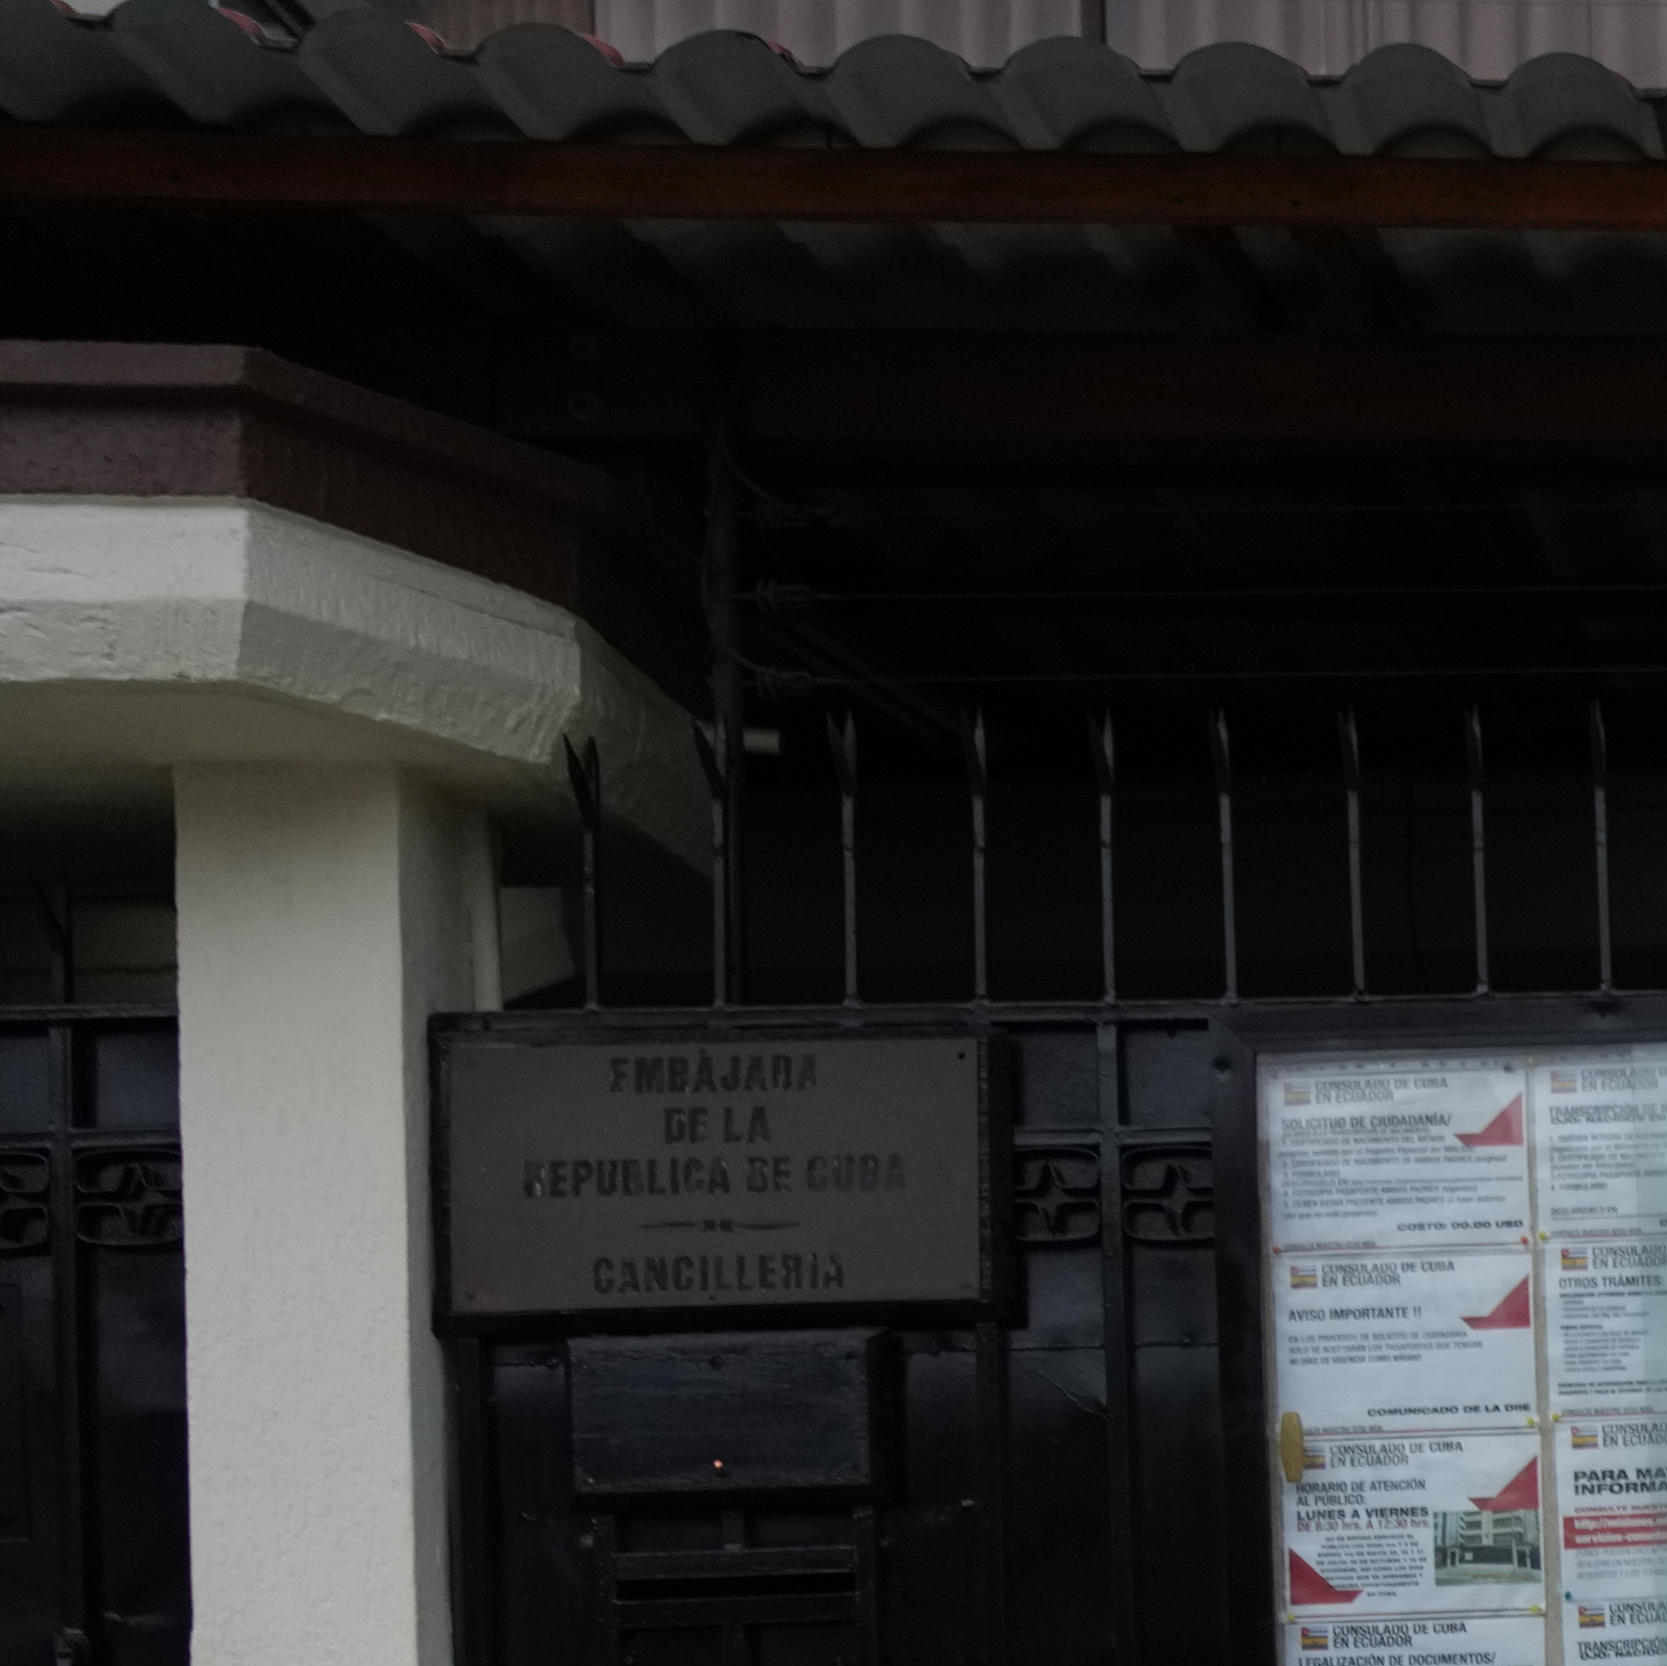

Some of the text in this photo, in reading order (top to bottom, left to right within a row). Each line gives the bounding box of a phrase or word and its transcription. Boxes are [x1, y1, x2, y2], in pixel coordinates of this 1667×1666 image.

[1395, 1079, 1410, 1089] DE
[664, 1106, 771, 1145] DE LA
[1281, 1117, 1346, 1130] SOLICITUD
[1350, 1116, 1367, 1128] DE
[746, 1156, 792, 1193] DE
[806, 1152, 908, 1192] CUBA
[1401, 1262, 1417, 1272] DE
[1559, 1277, 1598, 1289] OTROS
[1288, 1309, 1325, 1322] AVISO
[1329, 1307, 1408, 1320] IMPORTANTE
[1368, 1406, 1459, 1417] COMUNICADO
[1464, 1405, 1480, 1413] DE
[1410, 1443, 1425, 1453] DE
[1573, 1470, 1628, 1482] PARA
[1296, 1482, 1347, 1493] HORARIO
[1351, 1481, 1366, 1492] DE
[1296, 1495, 1312, 1506] AL
[1297, 1507, 1429, 1521] LUNES A VIERNES
[1413, 1624, 1429, 1634] DE
[1388, 1655, 1404, 1666] DE
